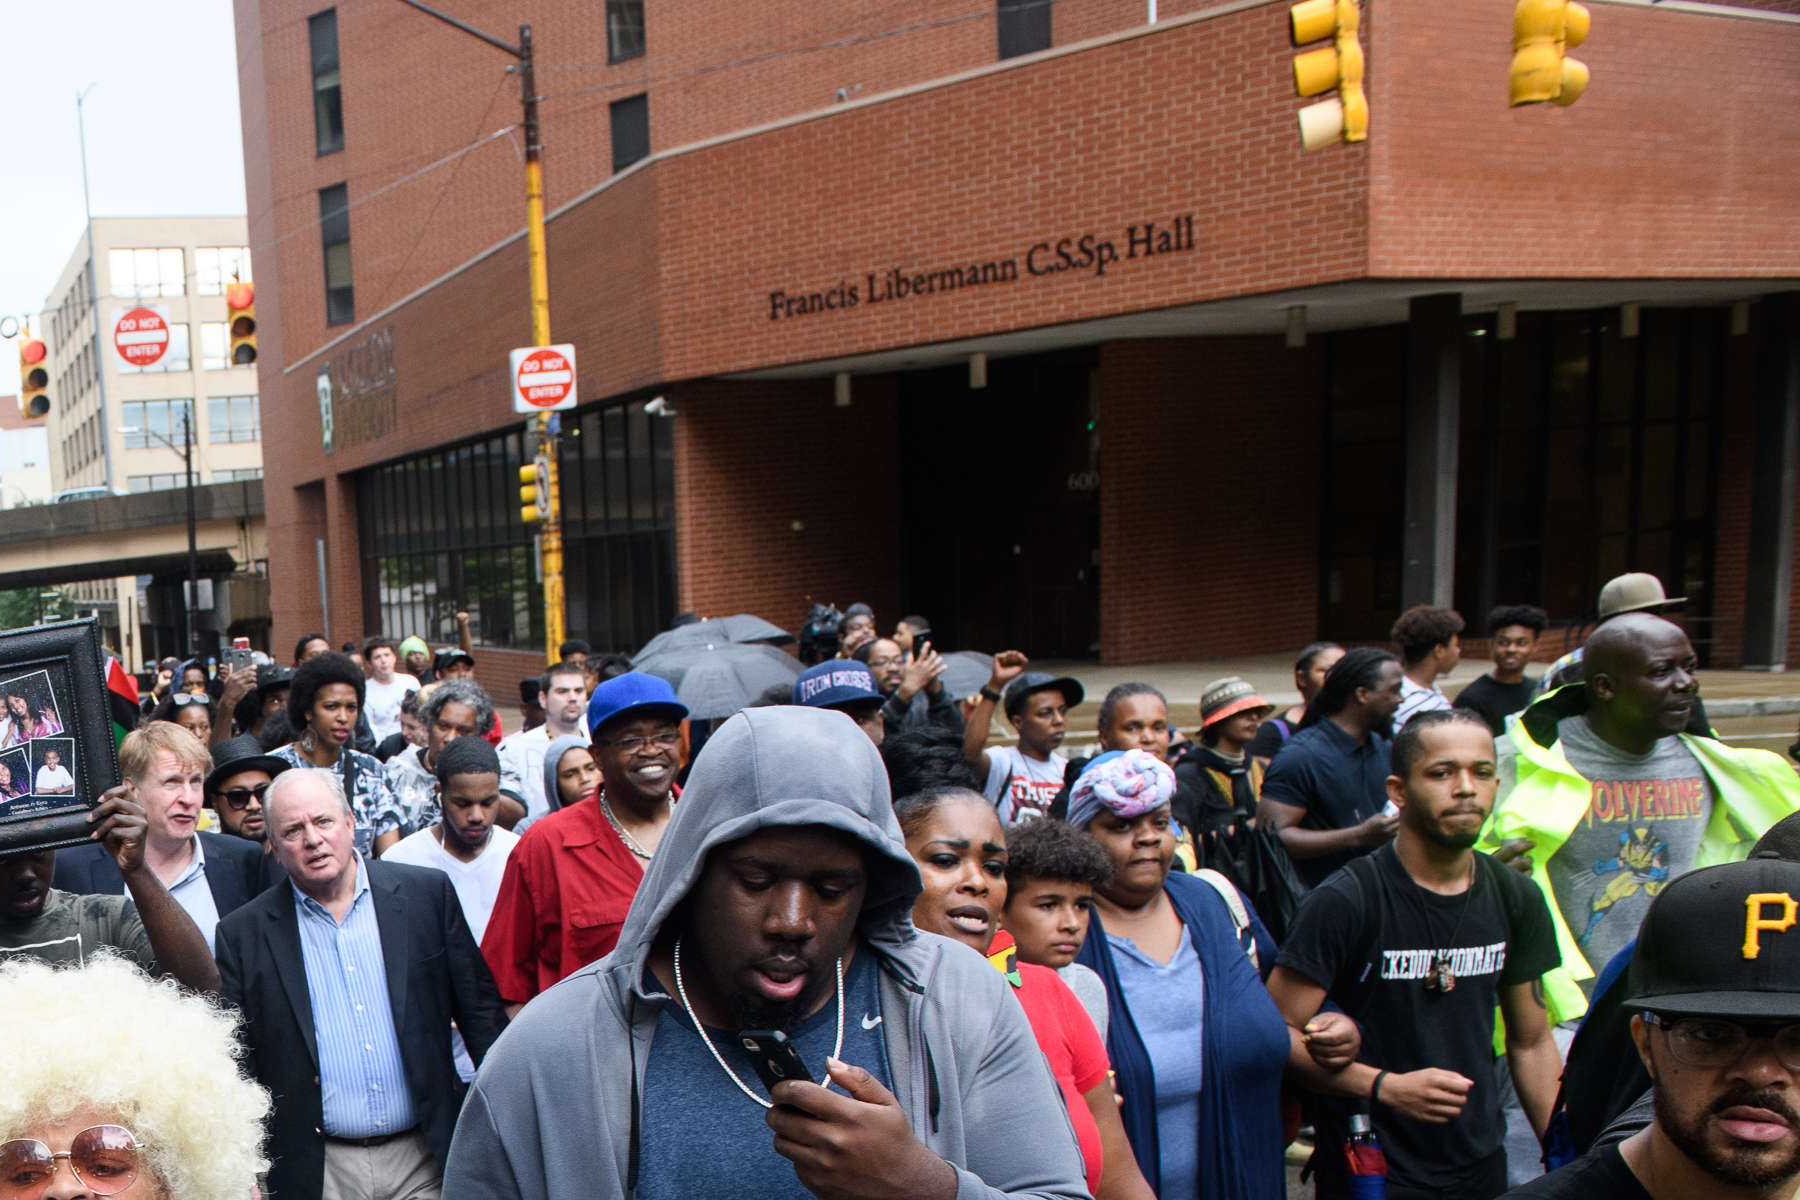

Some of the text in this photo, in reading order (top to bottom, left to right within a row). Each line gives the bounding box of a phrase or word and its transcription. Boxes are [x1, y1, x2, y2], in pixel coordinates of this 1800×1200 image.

[769, 215, 1196, 320] Francis Libermann C.S.Sp. Hall
[120, 317, 160, 332] DO NOT
[126, 344, 161, 358] ENTER
[523, 357, 564, 373] DO NOT
[528, 385, 564, 399] ENTER
[801, 670, 873, 702] IRON CROSS
[1742, 892, 1799, 959] P
